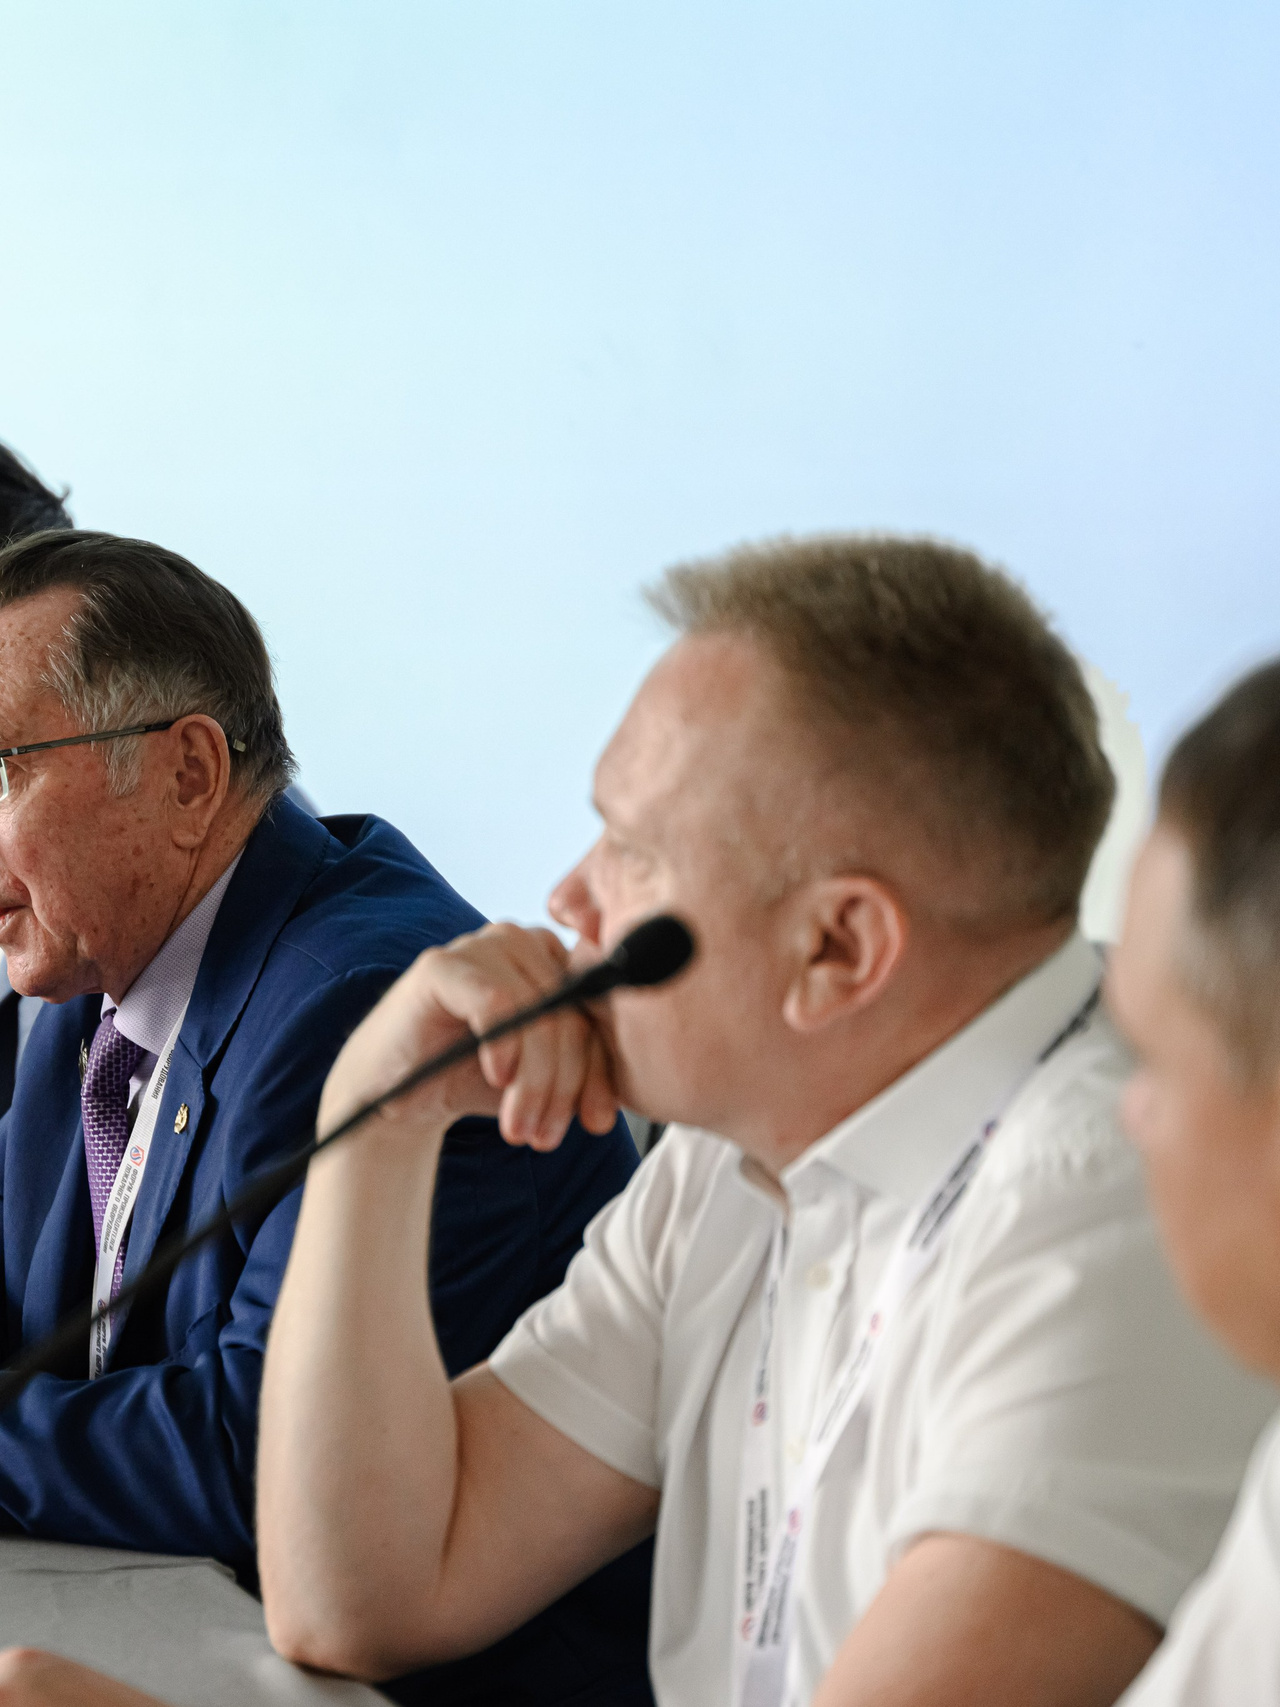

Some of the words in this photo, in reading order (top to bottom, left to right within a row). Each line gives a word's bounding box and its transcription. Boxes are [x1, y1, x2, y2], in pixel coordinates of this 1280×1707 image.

[115, 1163, 132, 1203] ПОЖАРНОГО
[127, 1168, 138, 1193] ФОРУМ
[109, 1193, 130, 1252] ПРОИЗВОДИТЕЛЕЙ
